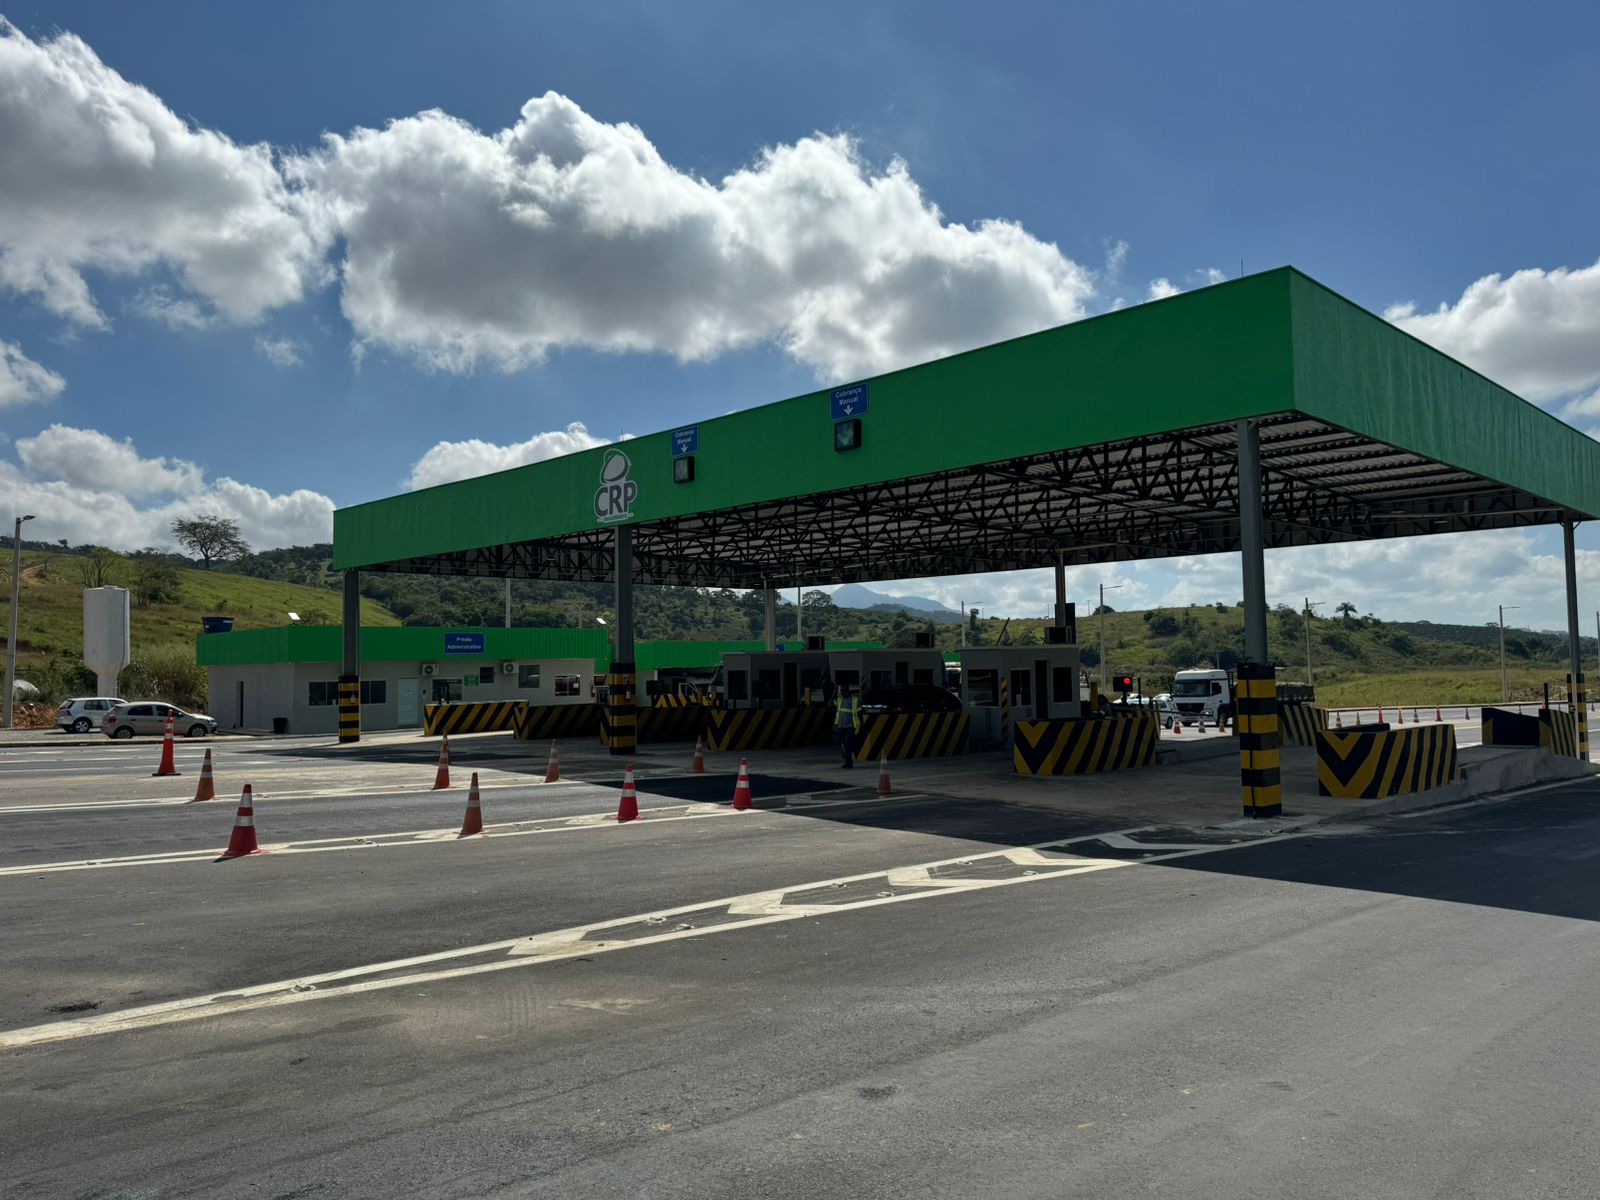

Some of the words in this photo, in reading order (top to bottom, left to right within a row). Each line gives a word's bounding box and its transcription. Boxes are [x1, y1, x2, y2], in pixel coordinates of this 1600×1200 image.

[835, 387, 861, 398] Cobrança
[839, 396, 858, 405] Manual
[595, 482, 637, 517] CRP
